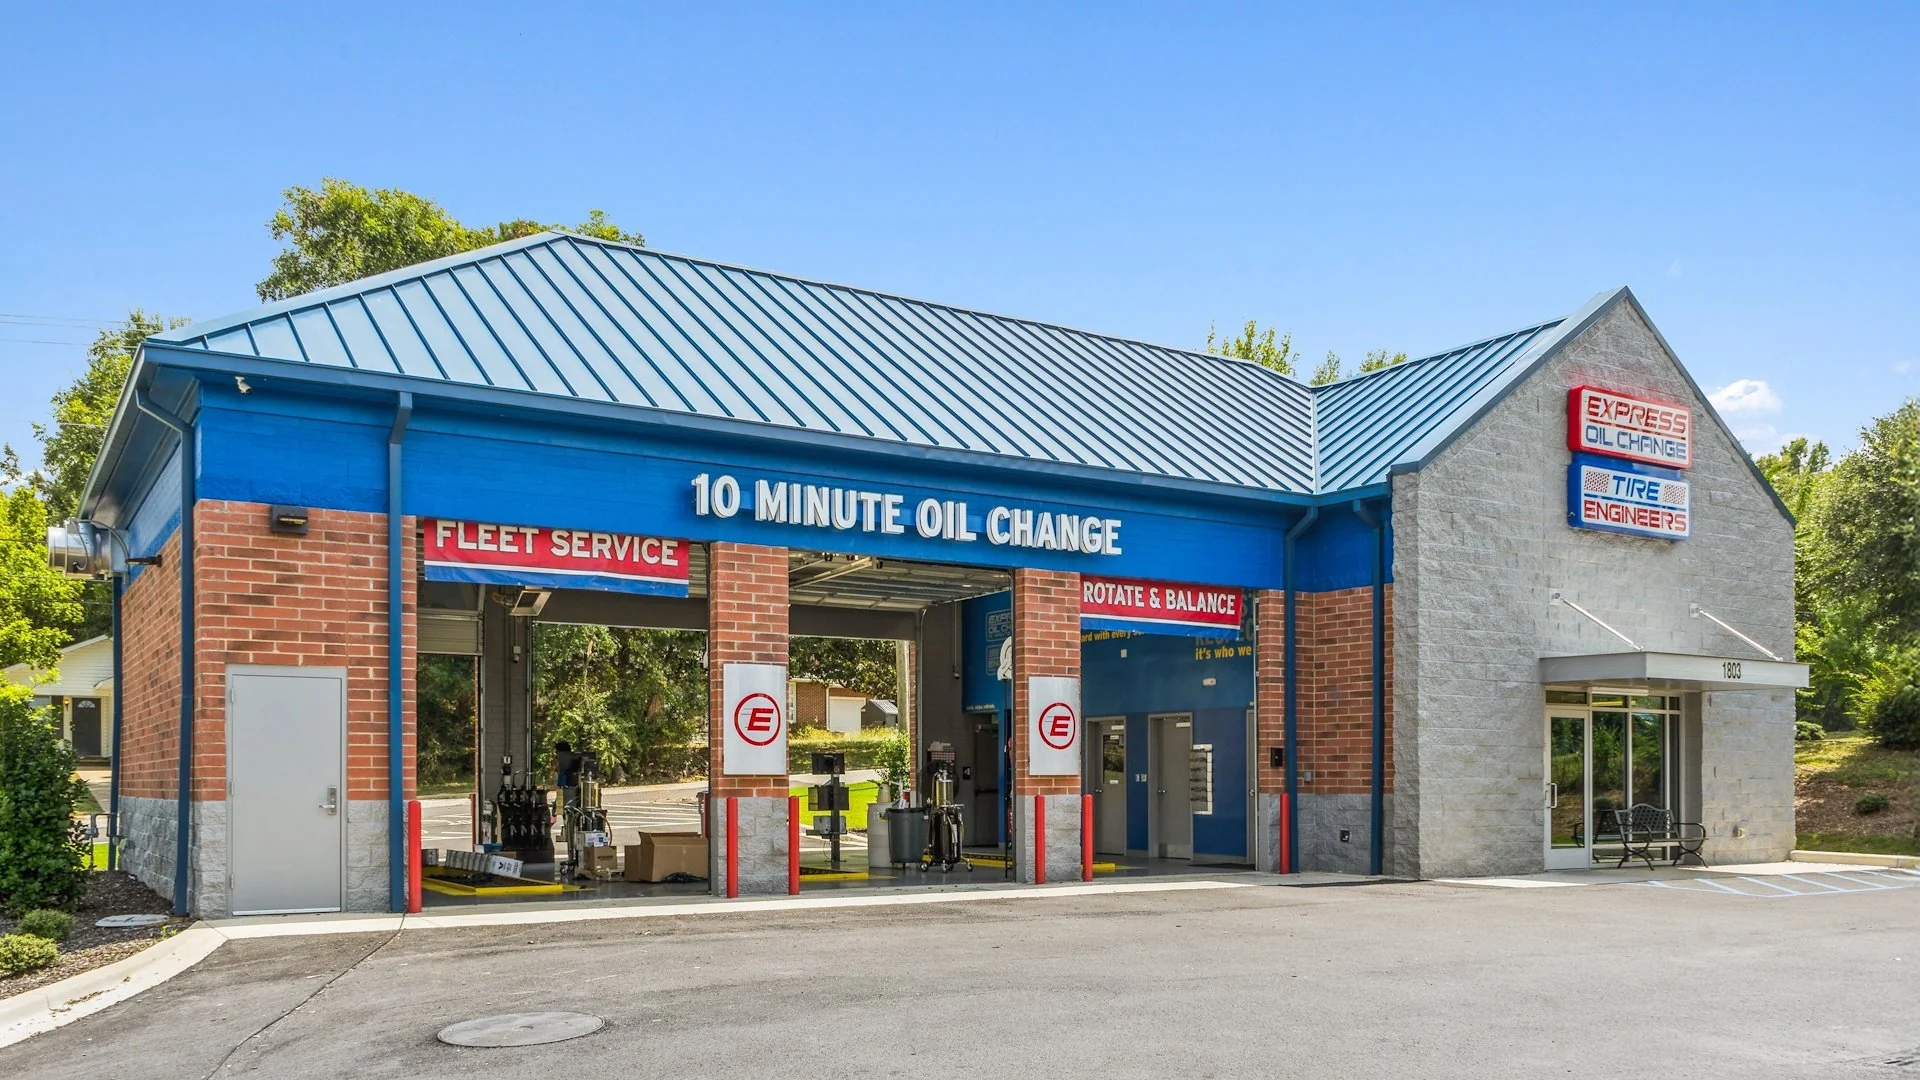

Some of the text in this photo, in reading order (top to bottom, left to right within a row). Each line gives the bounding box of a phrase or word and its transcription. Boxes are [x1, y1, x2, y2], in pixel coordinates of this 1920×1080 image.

[1587, 396, 1687, 433] EXPRESS
[1586, 425, 1687, 460] OIL CHANGE
[1613, 475, 1661, 501] TIRE
[691, 473, 1122, 555] 10 MINUTE OIL CHANGE
[1584, 500, 1687, 532] ENGINEERS
[436, 519, 679, 567] FLEET SERVICE
[1083, 581, 1145, 608] ROTATE
[1149, 587, 1161, 609] &
[1165, 589, 1236, 615] BALANCE
[1093, 630, 1110, 641] with
[1111, 629, 1131, 639] every
[1195, 645, 1252, 661] it's who we
[1722, 661, 1741, 679] 1803
